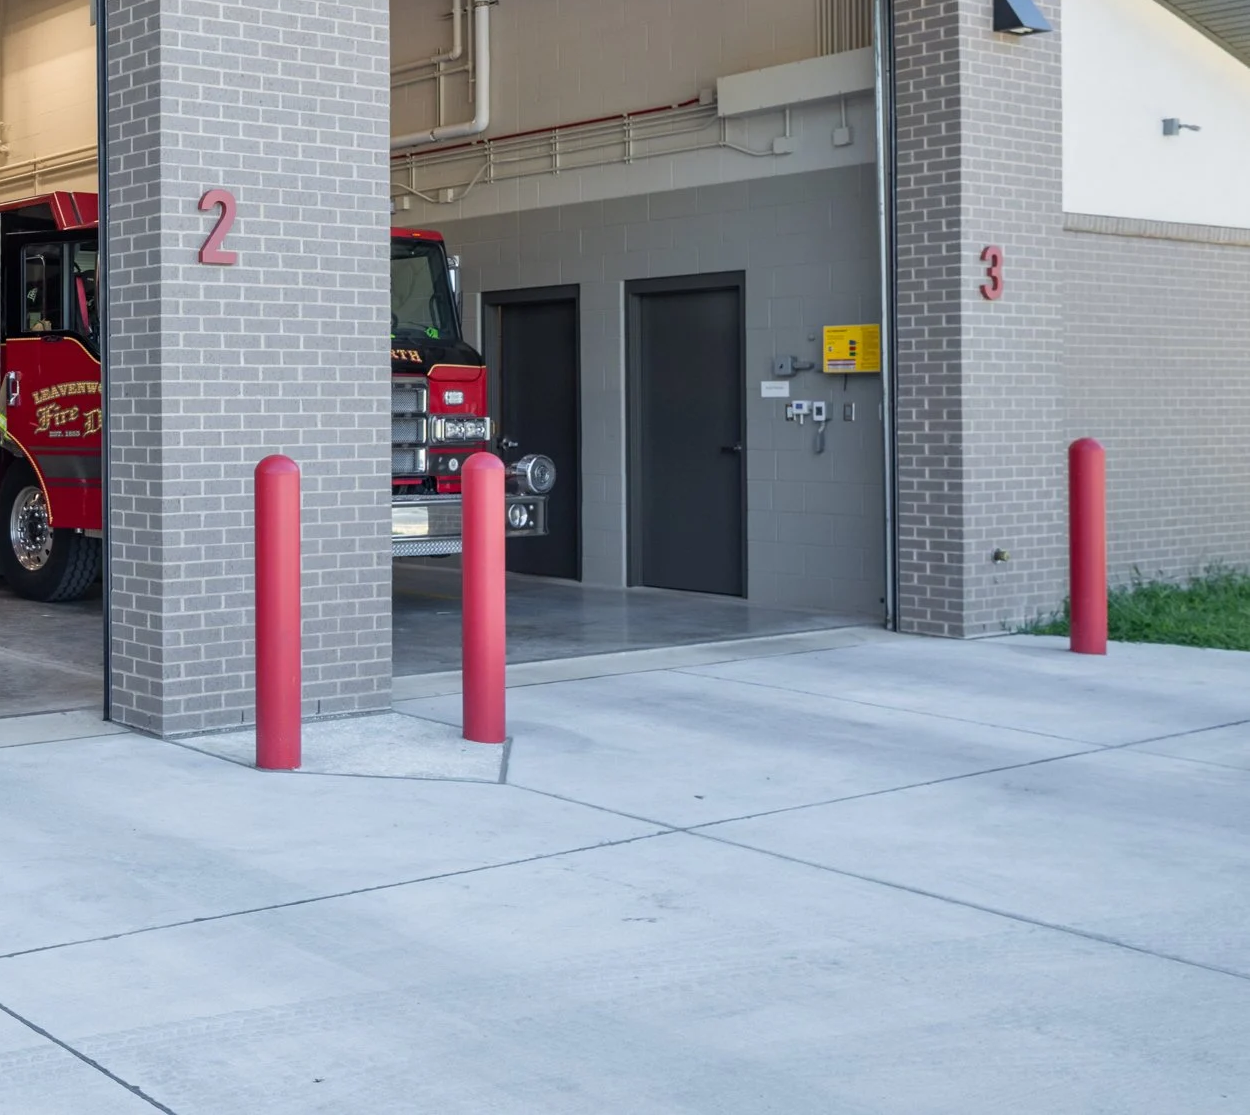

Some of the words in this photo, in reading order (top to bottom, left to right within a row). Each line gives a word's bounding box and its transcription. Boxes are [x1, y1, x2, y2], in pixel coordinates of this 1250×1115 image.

[198, 189, 237, 265] 2
[979, 245, 1004, 301] 3
[391, 349, 422, 363] RTH
[34, 403, 79, 435] Fire
[82, 408, 102, 438] D
